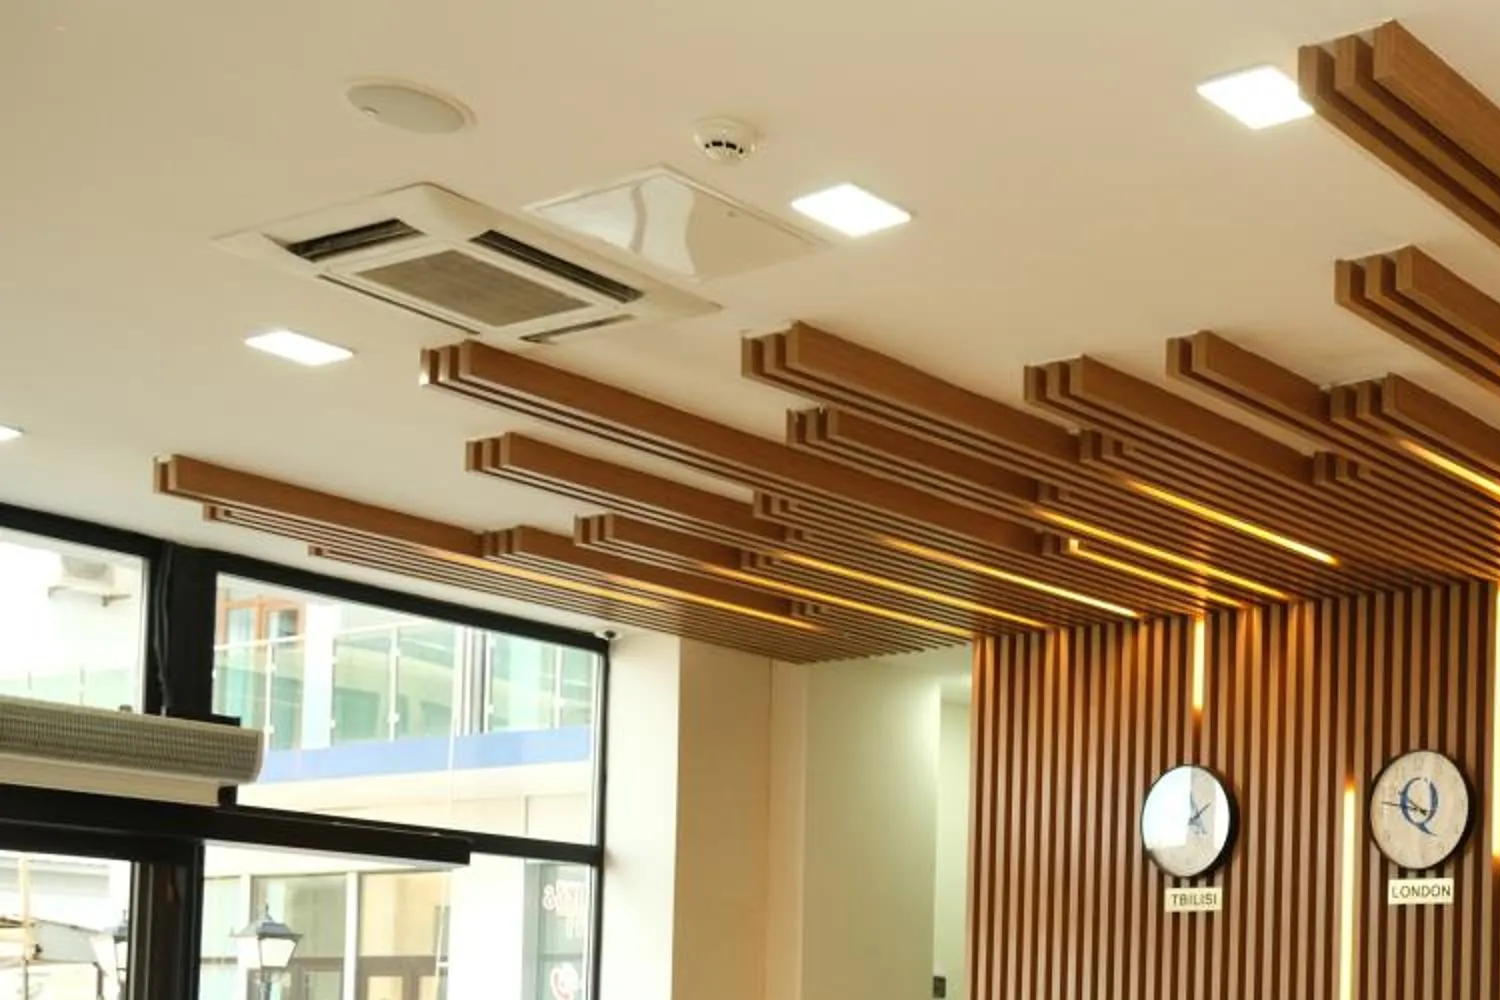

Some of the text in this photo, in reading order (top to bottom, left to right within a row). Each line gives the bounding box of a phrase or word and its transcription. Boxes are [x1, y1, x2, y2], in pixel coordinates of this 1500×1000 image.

[1399, 776, 1442, 837] Q
[1391, 884, 1451, 899] LONDON
[1171, 892, 1217, 907] TBILISI
